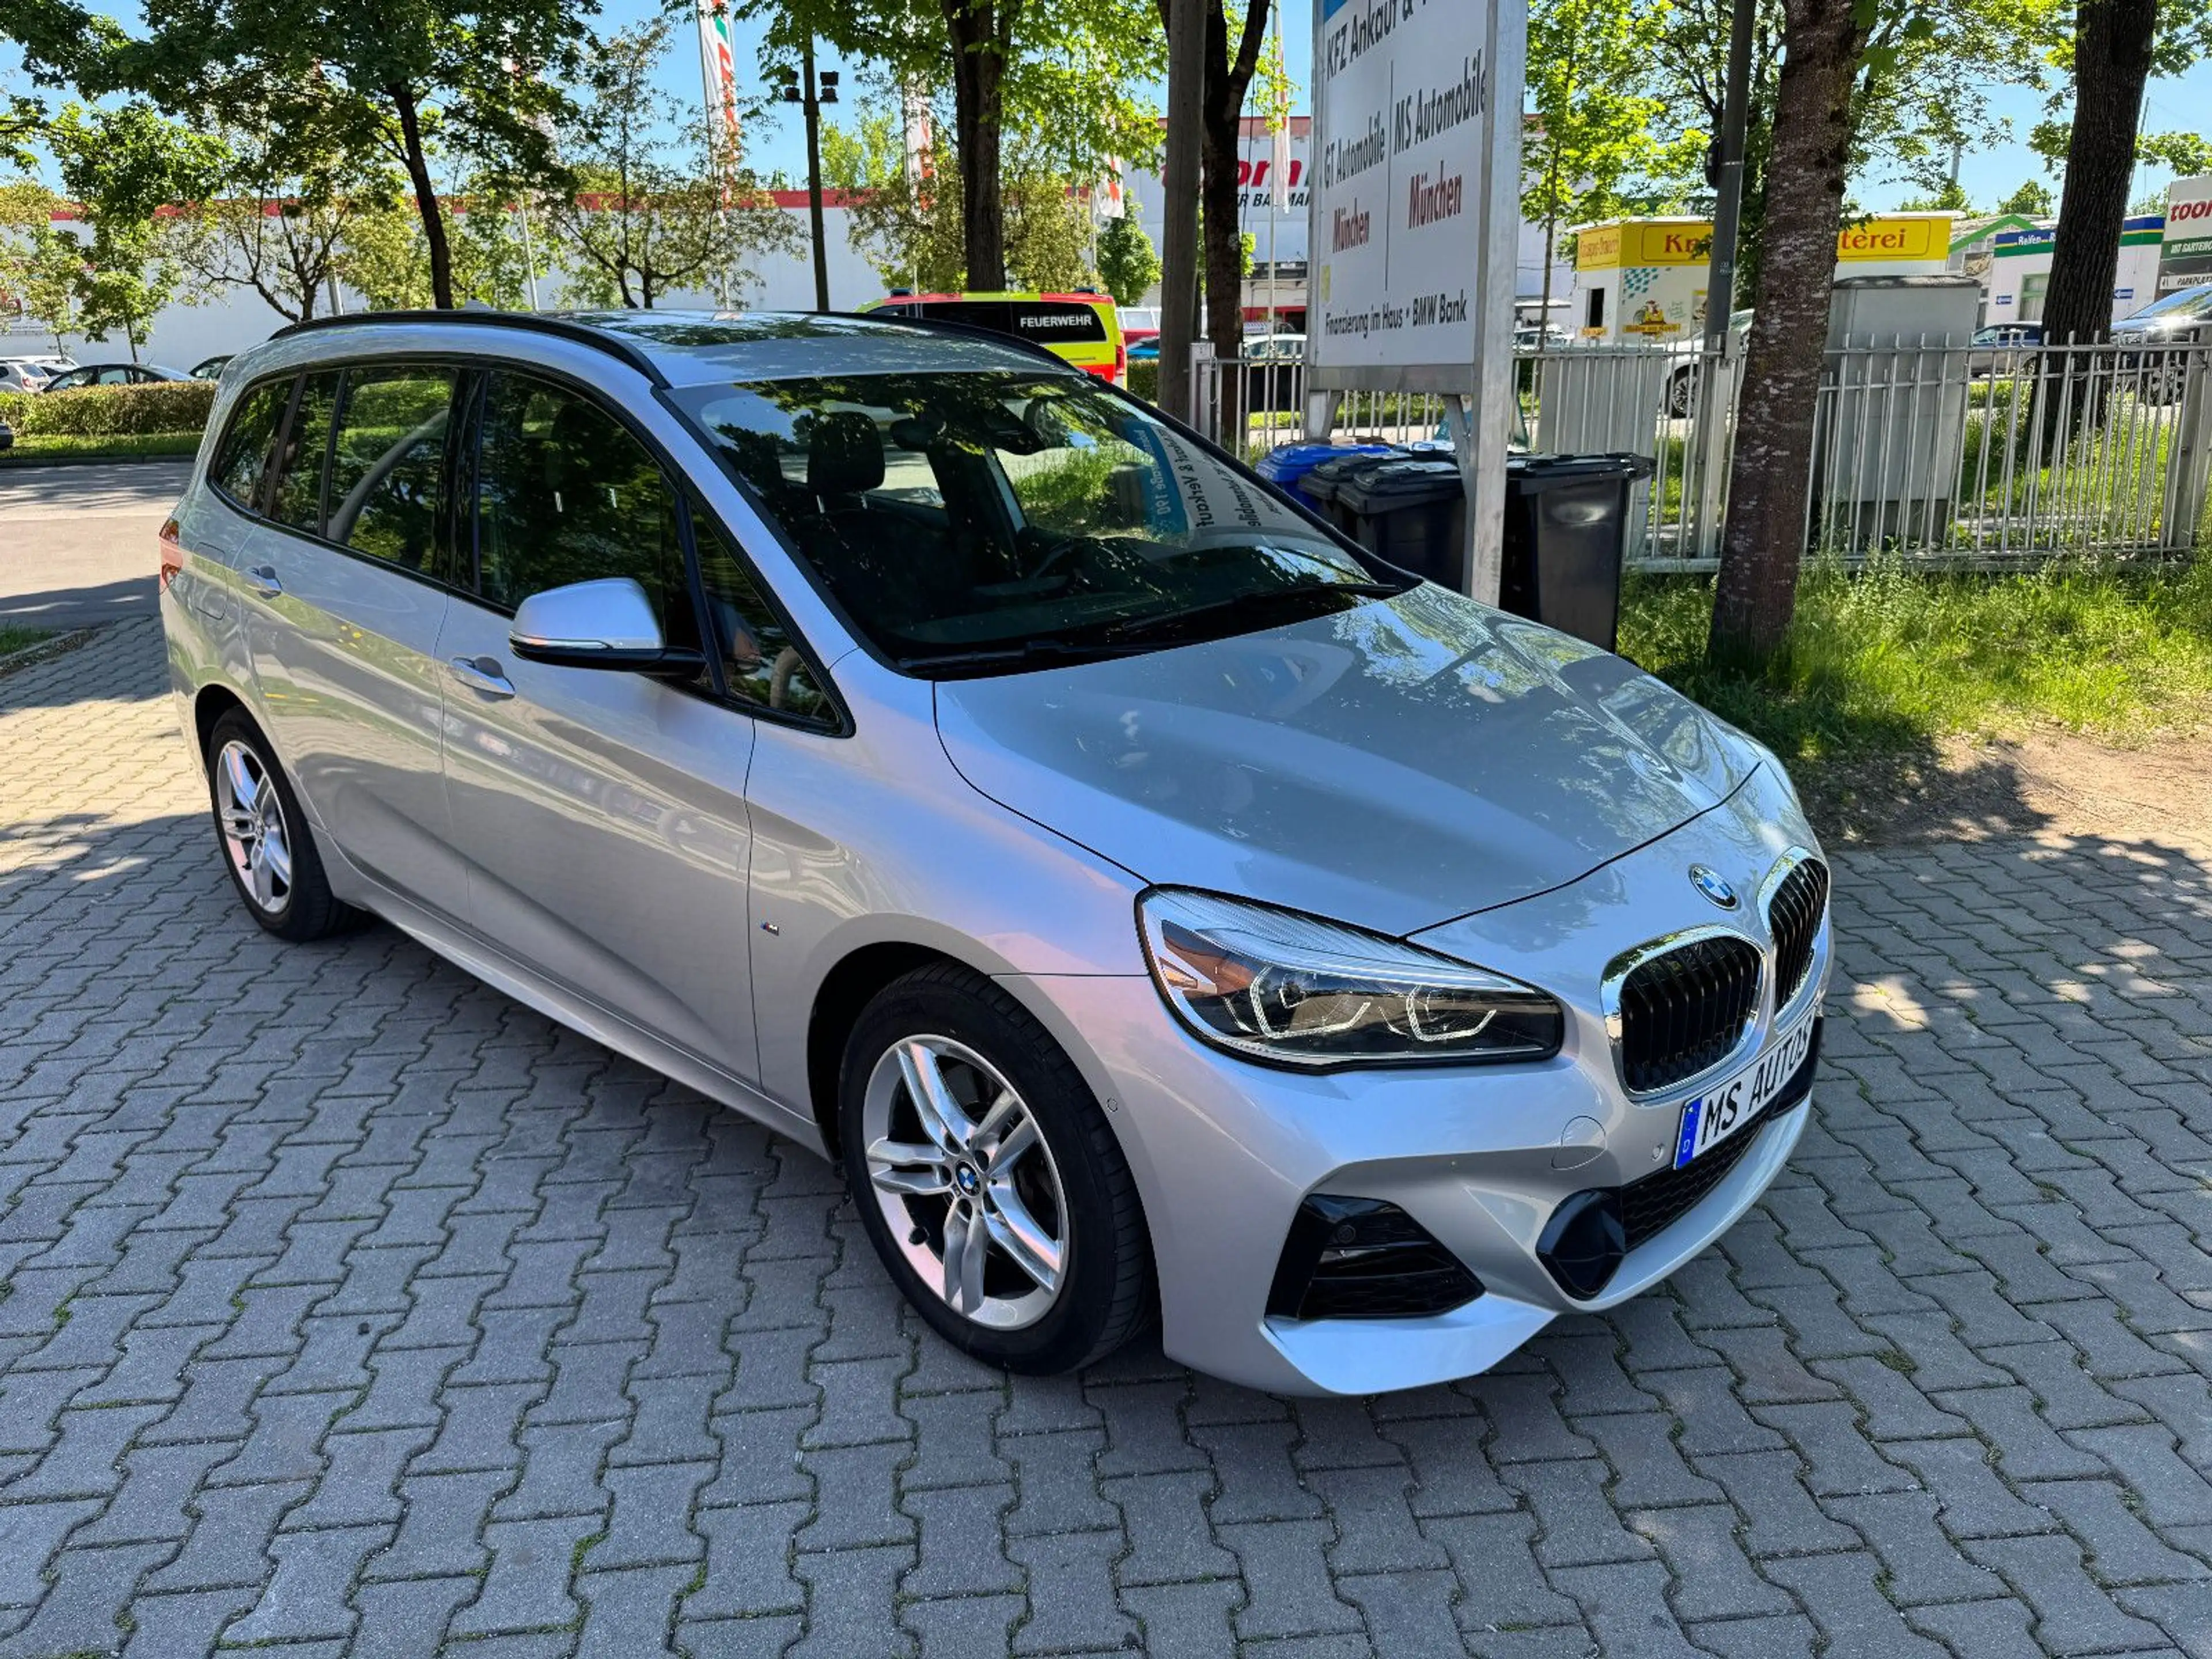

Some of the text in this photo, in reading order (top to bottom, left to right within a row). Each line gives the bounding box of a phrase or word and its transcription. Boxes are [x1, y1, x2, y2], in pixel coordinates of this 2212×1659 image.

[1327, 22, 1348, 82] KFZ
[1336, 110, 1385, 184] Automobile
[1394, 95, 1412, 155] MS
[1409, 160, 1462, 229] München
[1332, 197, 1370, 253] München
[1020, 315, 1092, 328] FEUERWEHR
[1325, 289, 1467, 339] Finanzierung im Haus BMW Bank
[1701, 1081, 1741, 1146] MS
[1683, 1139, 1690, 1152] D
